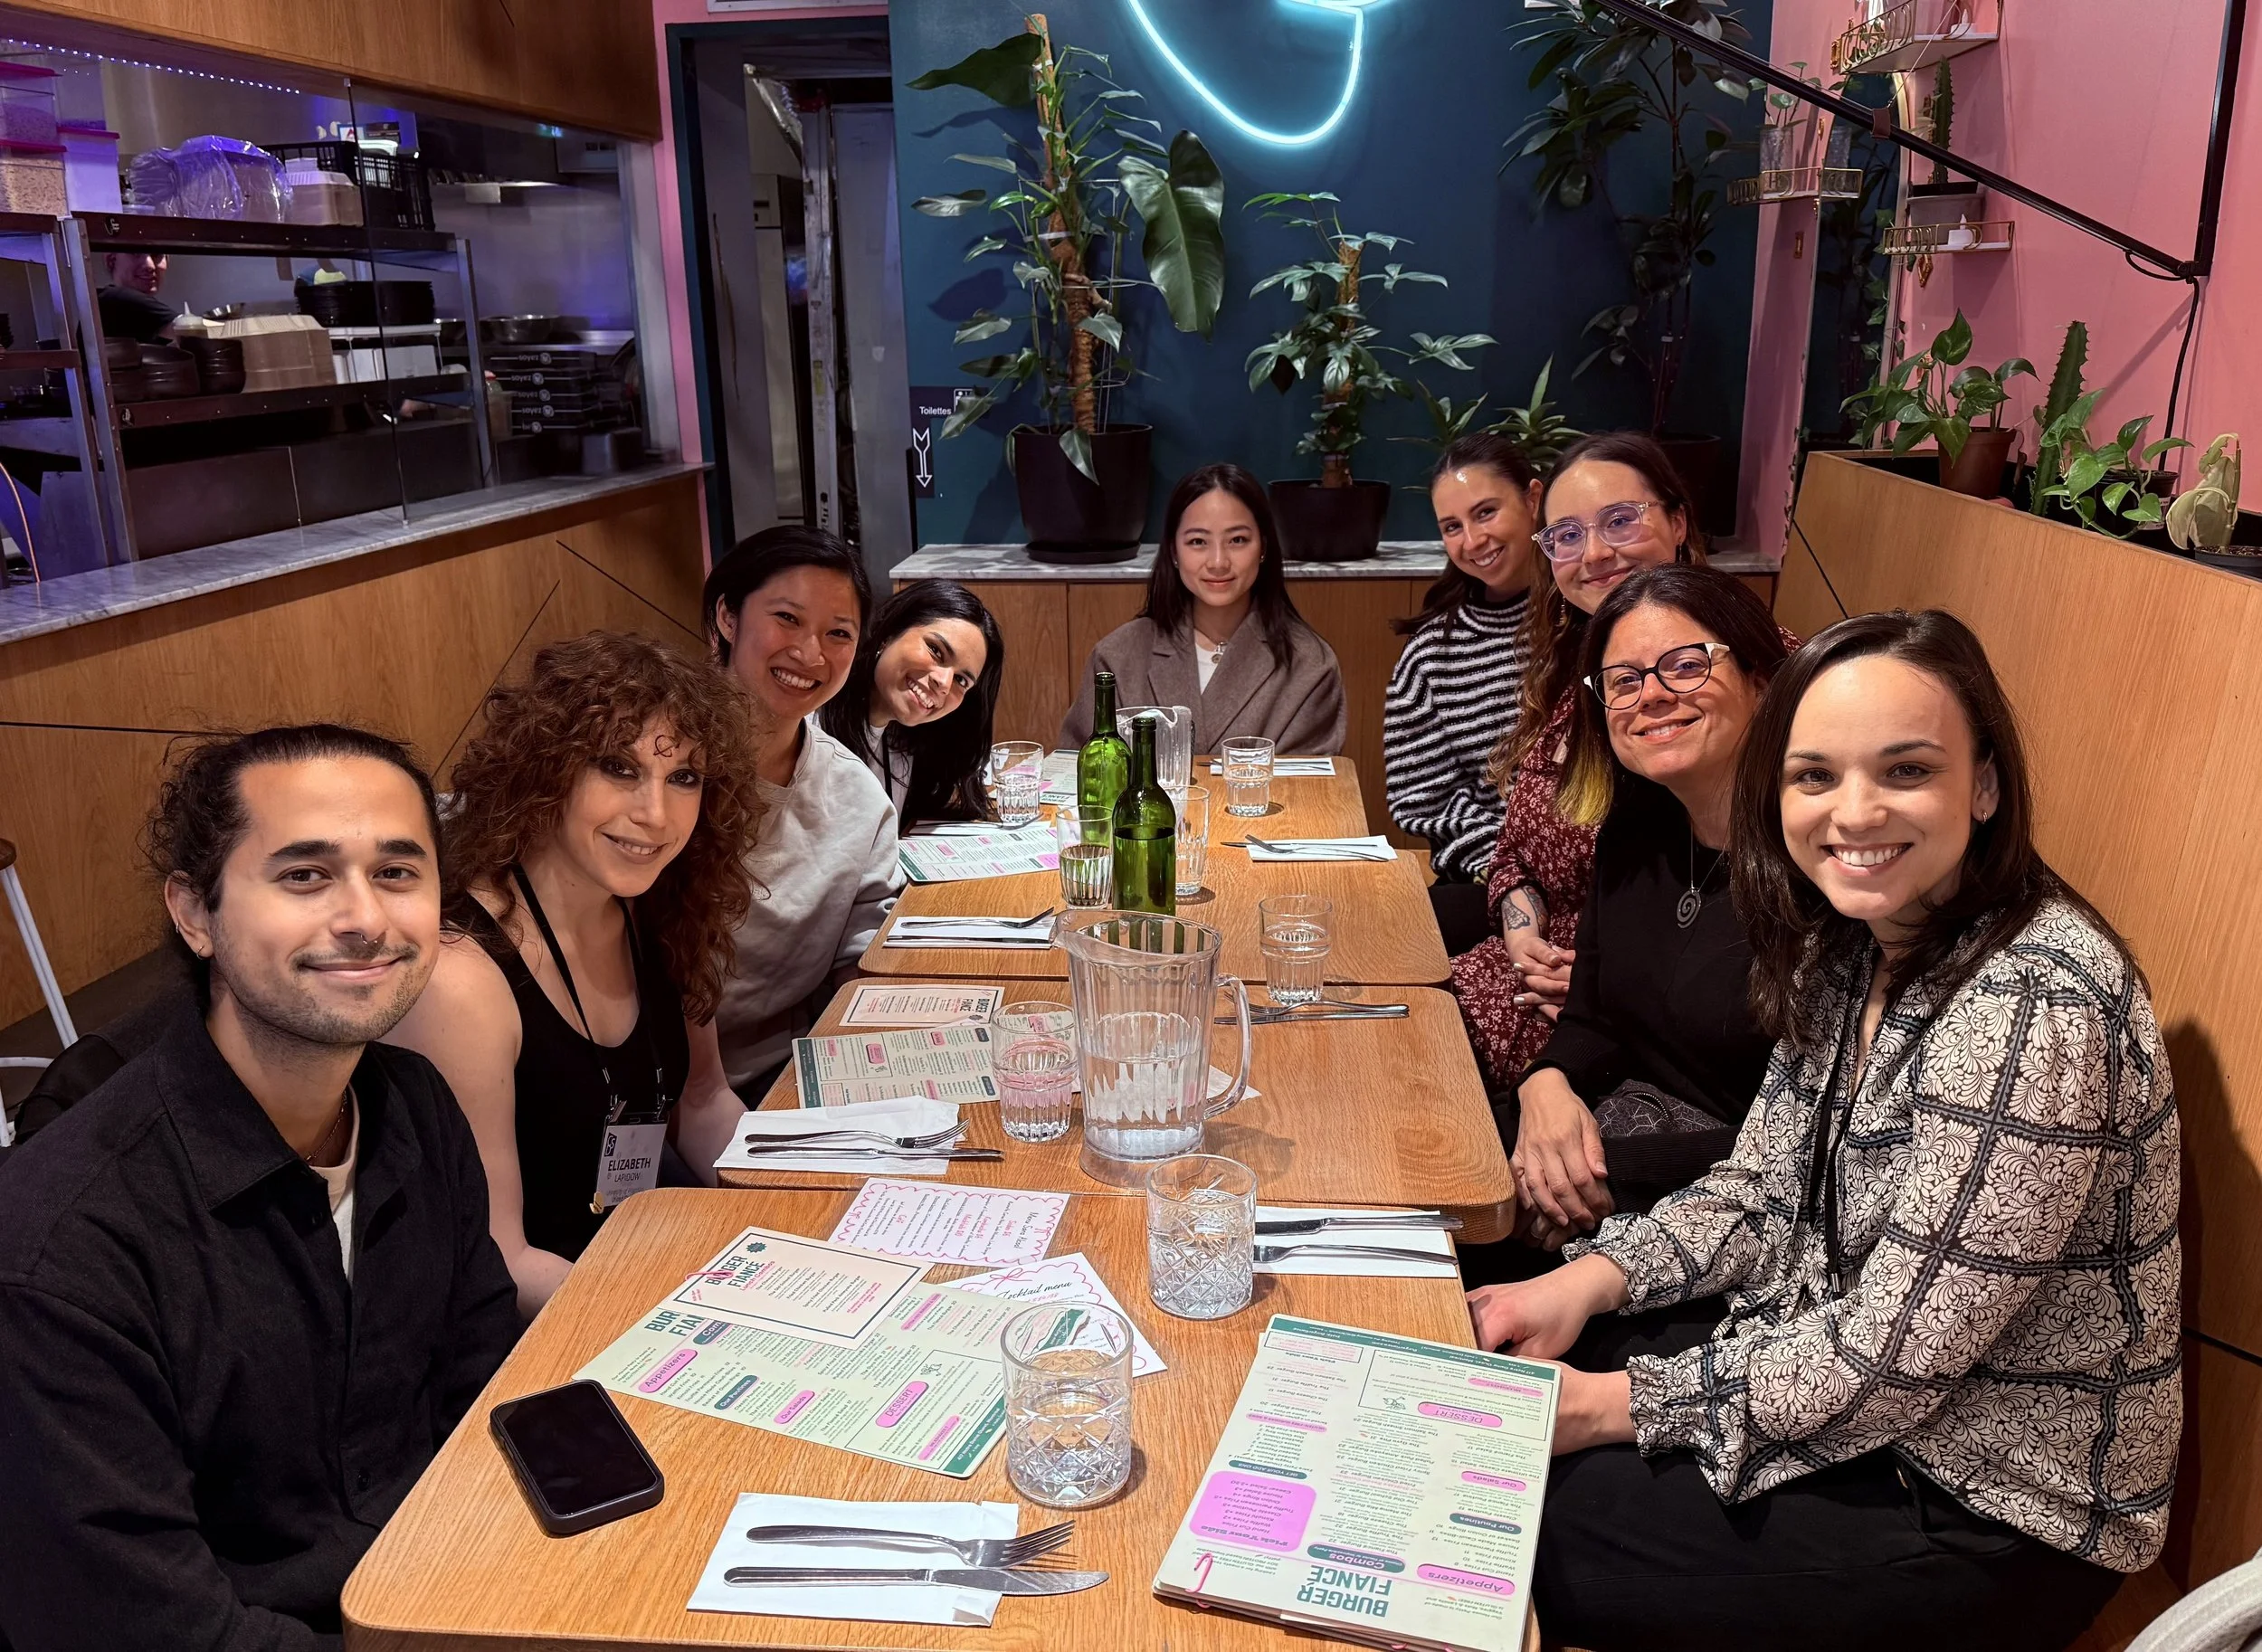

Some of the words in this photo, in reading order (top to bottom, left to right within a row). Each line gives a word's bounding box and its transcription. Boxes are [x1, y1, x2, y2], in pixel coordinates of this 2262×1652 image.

[919, 406, 952, 414] Toilettes
[975, 998, 989, 1012] BURGER
[608, 1158, 651, 1171] ELIZABETH
[614, 1173, 641, 1182] LAPIDOW
[1024, 1211, 1039, 1223] Menu
[1018, 1224, 1032, 1235] Sans
[1012, 1236, 1027, 1248] Alcool
[727, 1260, 765, 1286] FIANCÉ
[738, 1277, 757, 1290] Lunch
[753, 1260, 776, 1277] Combos
[793, 1280, 808, 1291] Chicken
[804, 1271, 817, 1280] Burger
[817, 1281, 832, 1292] Chicken
[996, 1284, 1043, 1299] Cocktail
[1044, 1281, 1072, 1292] menu
[641, 1353, 689, 1387] Appetizers
[718, 1397, 732, 1406] Our
[727, 1379, 752, 1397] Poutines
[778, 1410, 793, 1419] Our
[787, 1395, 807, 1410] Salads
[883, 1388, 915, 1416] DESSERT
[1432, 1409, 1483, 1423] DESSERT
[1500, 1467, 1527, 1476] Ultimate
[1372, 1475, 1398, 1483] Chicken
[1472, 1475, 1499, 1484] Salads
[1344, 1499, 1365, 1507] Burger
[1459, 1515, 1497, 1528] Poutines
[1497, 1523, 1514, 1531] Our
[1200, 1525, 1227, 1533] Side
[1345, 1524, 1367, 1533] Burger
[1368, 1529, 1390, 1537] Truffle
[1259, 1536, 1288, 1546] Pick
[1497, 1534, 1520, 1543] Basket
[1460, 1542, 1497, 1552] Parmesan
[1327, 1552, 1385, 1570] Combos
[1491, 1562, 1515, 1570] Waffle
[1306, 1564, 1392, 1595] FIANCÉ
[1427, 1571, 1503, 1592] Appetizers
[1296, 1583, 1389, 1617] BURGER
